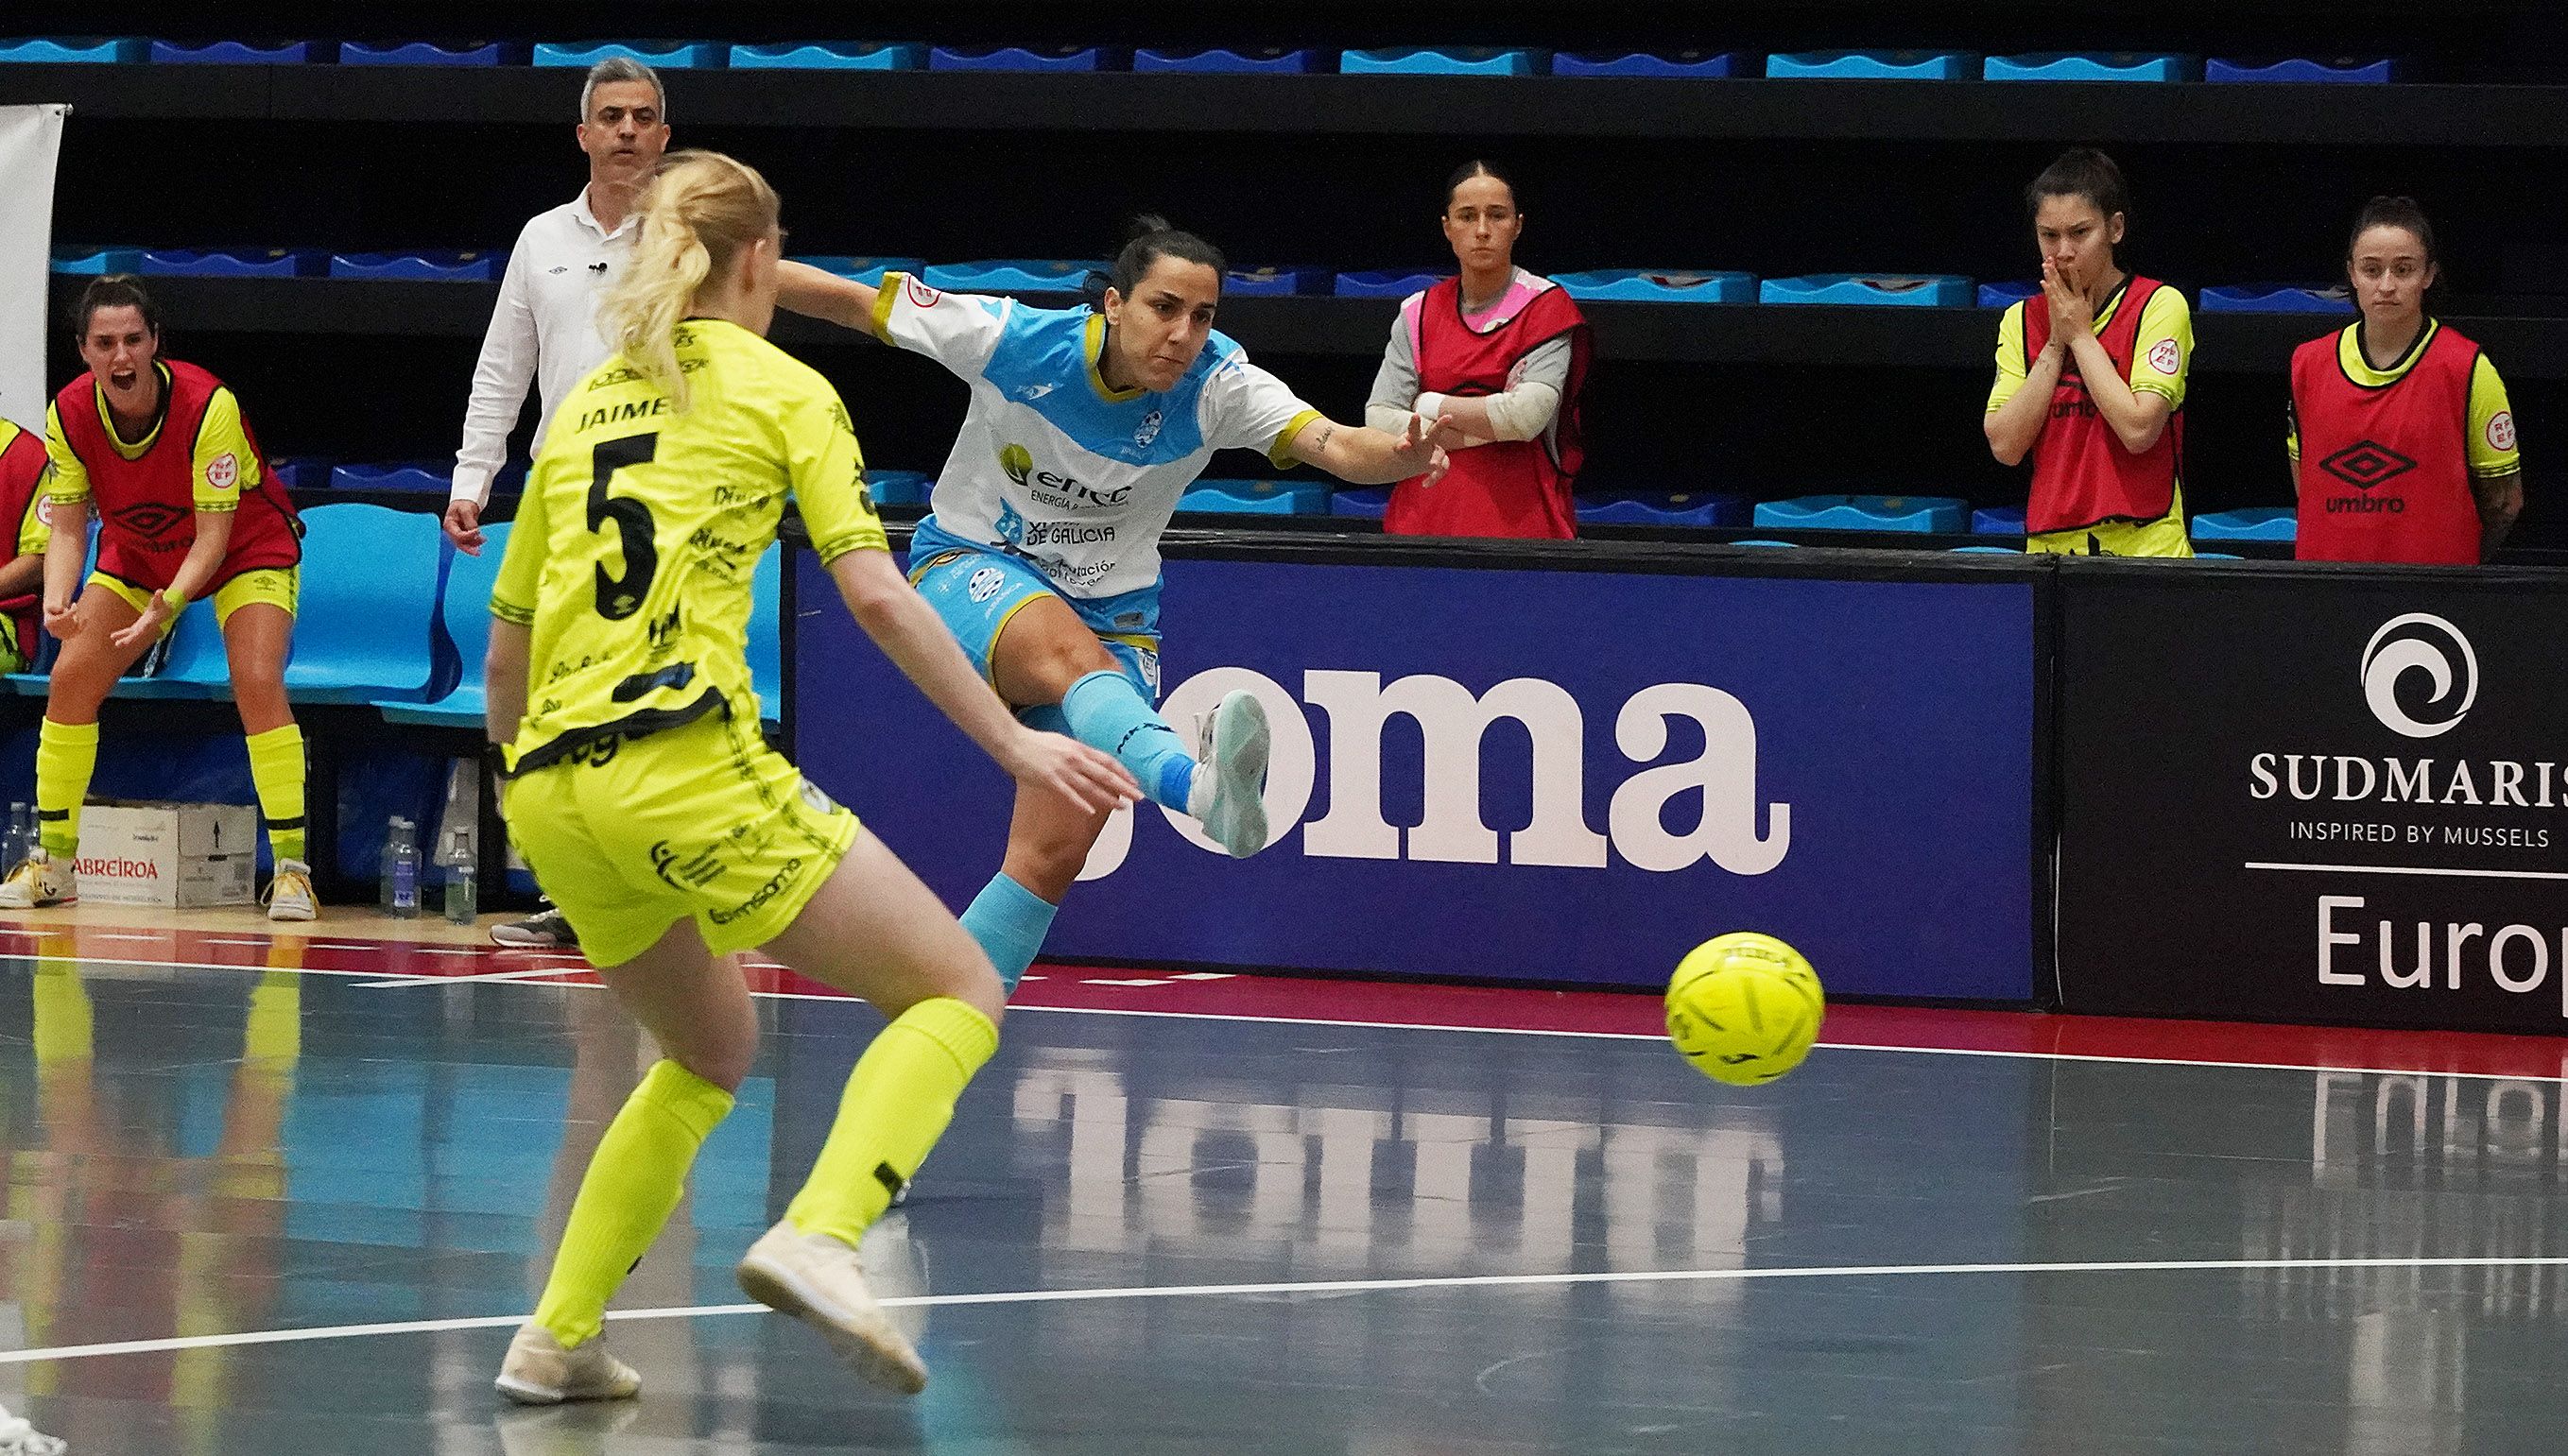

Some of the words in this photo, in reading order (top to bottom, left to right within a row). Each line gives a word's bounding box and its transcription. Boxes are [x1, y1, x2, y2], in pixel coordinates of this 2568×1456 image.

[2325, 493, 2405, 514] umbro
[586, 431, 660, 621] 5
[1026, 529, 1047, 546] DE
[1051, 526, 1115, 544] GALICIA
[1075, 665, 1792, 881] oma
[2249, 752, 2568, 808] SUDMARI
[2289, 820, 2397, 843] INSPIRED
[2406, 825, 2436, 844] BY
[2444, 826, 2550, 848] MUSSELS
